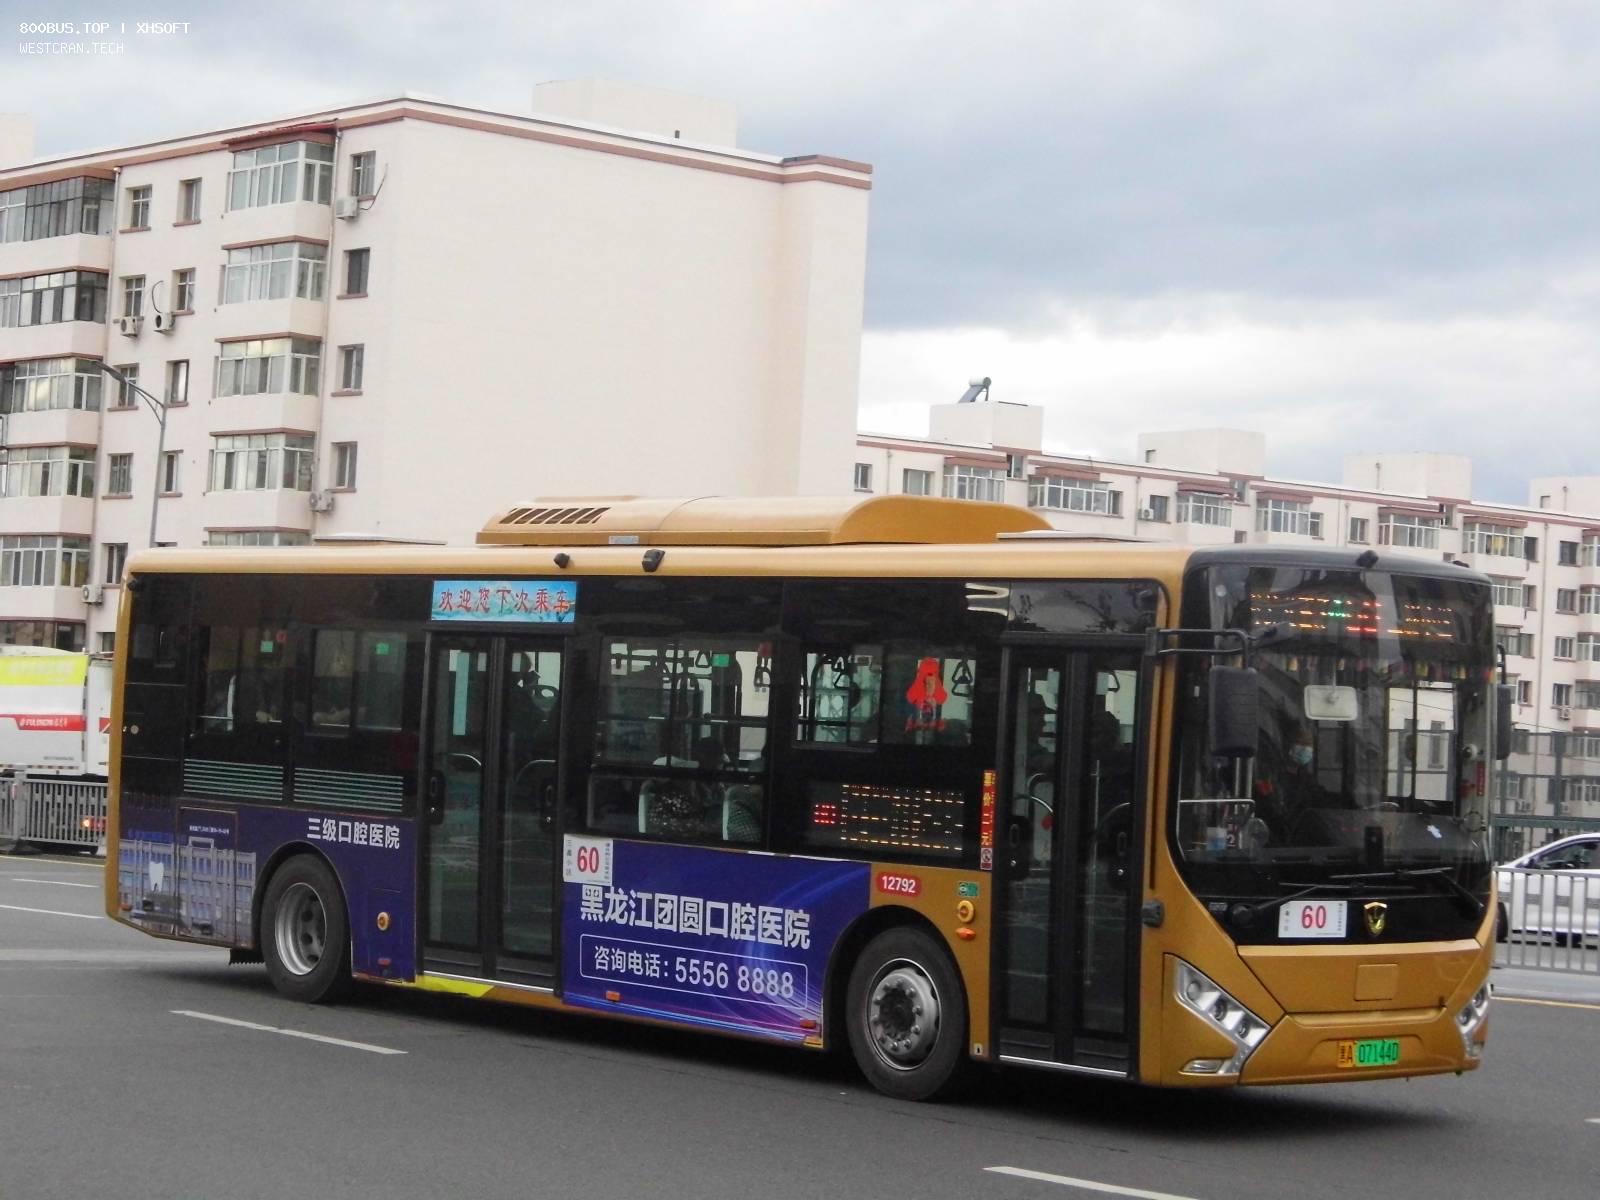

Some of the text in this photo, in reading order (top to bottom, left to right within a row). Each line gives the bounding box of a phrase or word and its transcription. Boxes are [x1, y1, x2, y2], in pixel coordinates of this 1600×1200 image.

[439, 587, 569, 613] 欢迎您下次乘车
[307, 817, 400, 849] 三级口腔医院
[577, 846, 600, 874] 60
[881, 875, 916, 894] 12792
[580, 884, 811, 950] 黑龙江团圆口腔医院
[1302, 905, 1326, 929] 60
[737, 964, 794, 999] 8888
